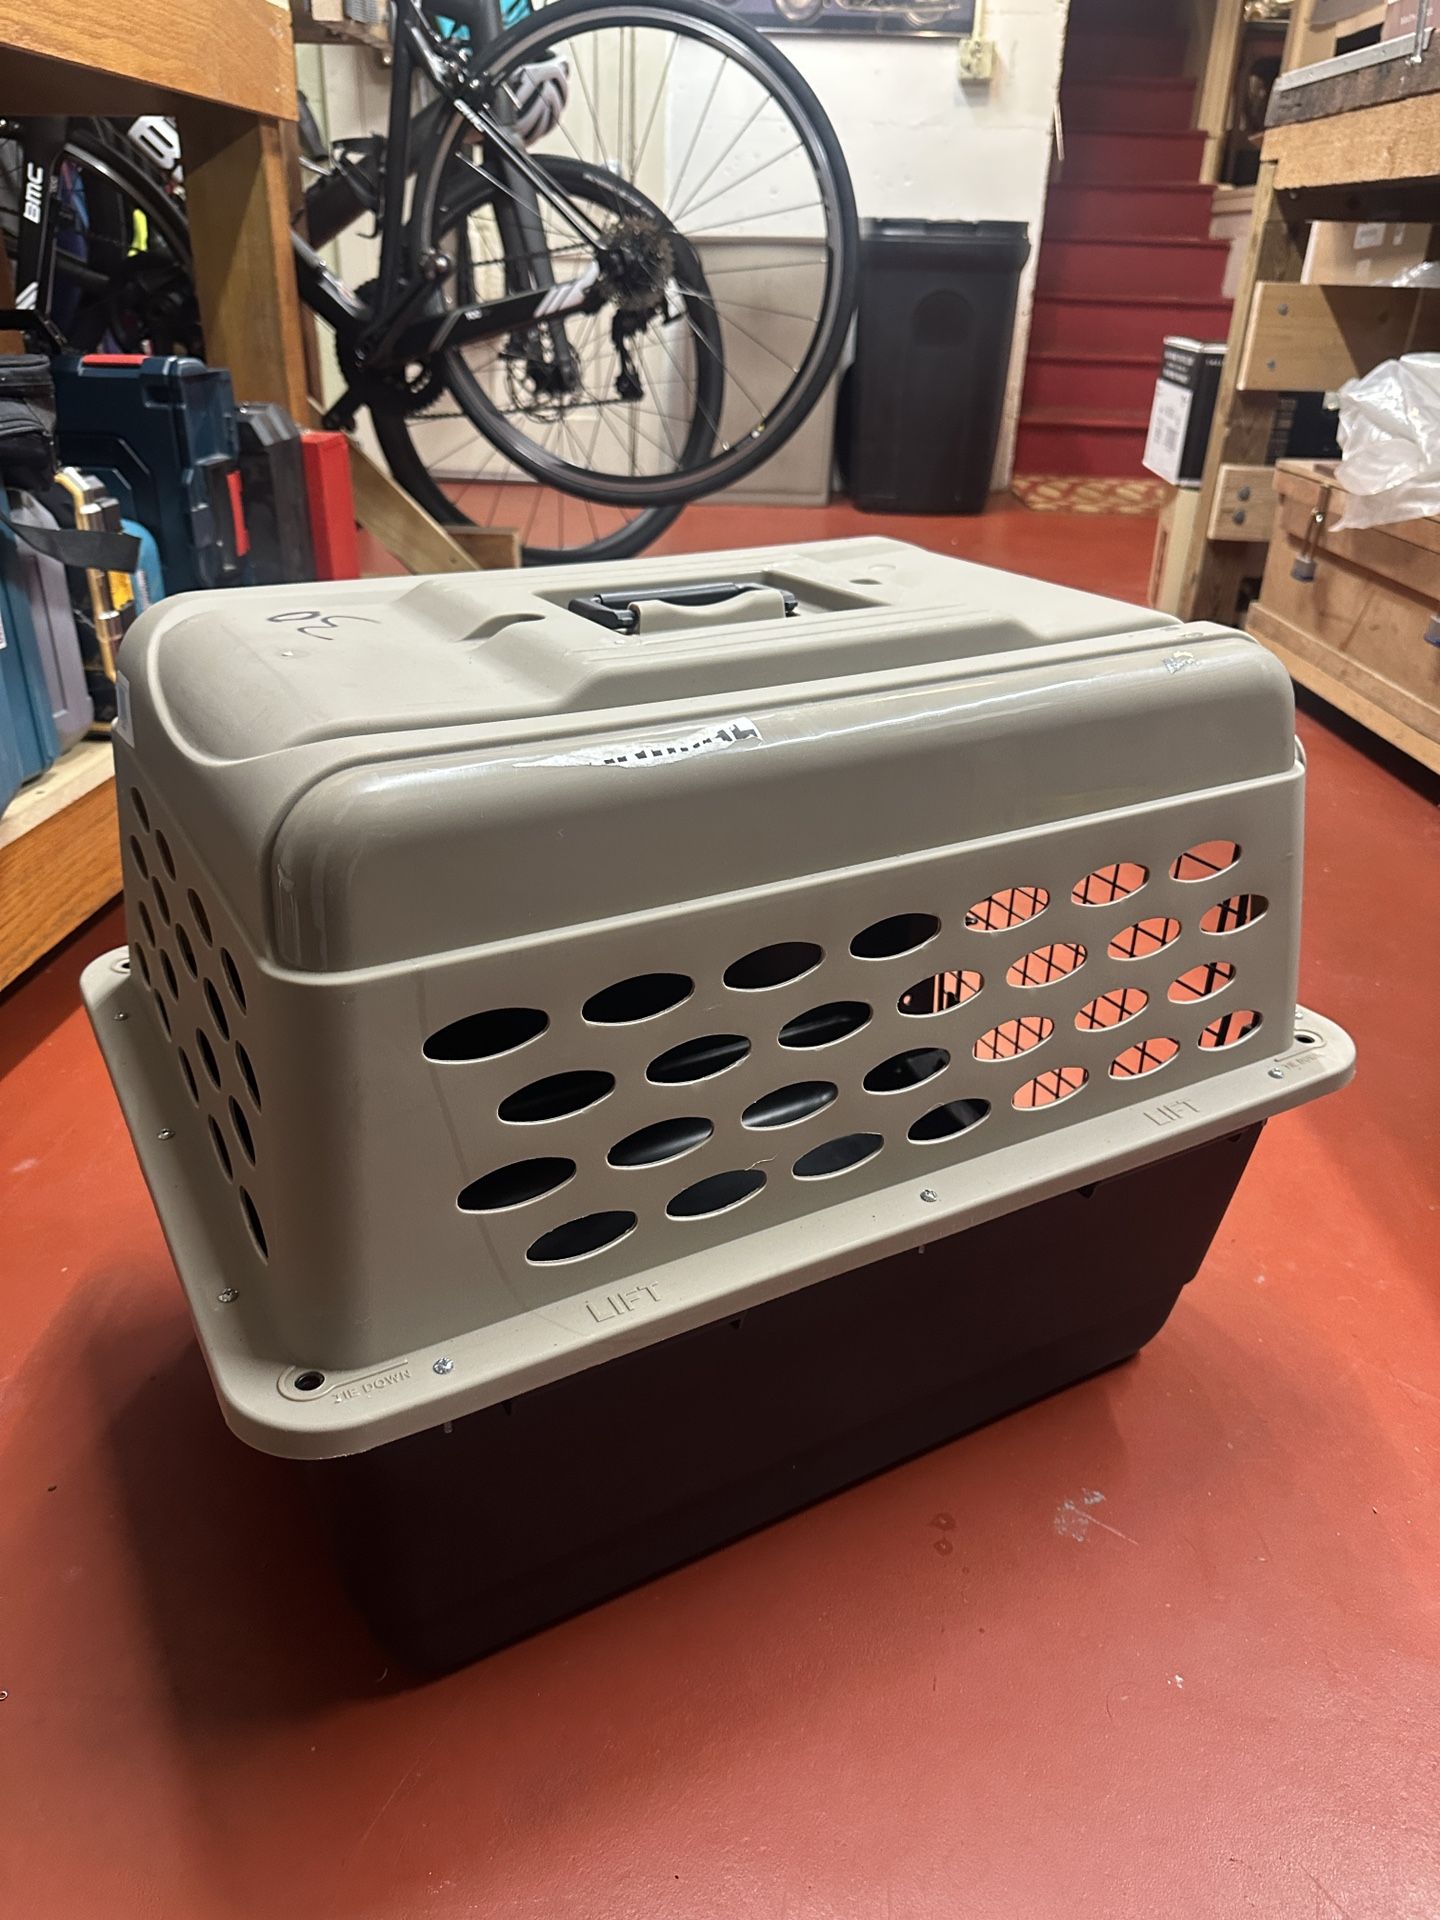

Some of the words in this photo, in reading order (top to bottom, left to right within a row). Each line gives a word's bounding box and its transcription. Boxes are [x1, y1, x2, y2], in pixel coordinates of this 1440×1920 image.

[23, 162, 44, 224] BMC
[1143, 1099, 1201, 1126] LIFT
[584, 1281, 661, 1323] LIFT
[332, 1387, 360, 1403] TIE
[361, 1369, 411, 1394] DOWN
